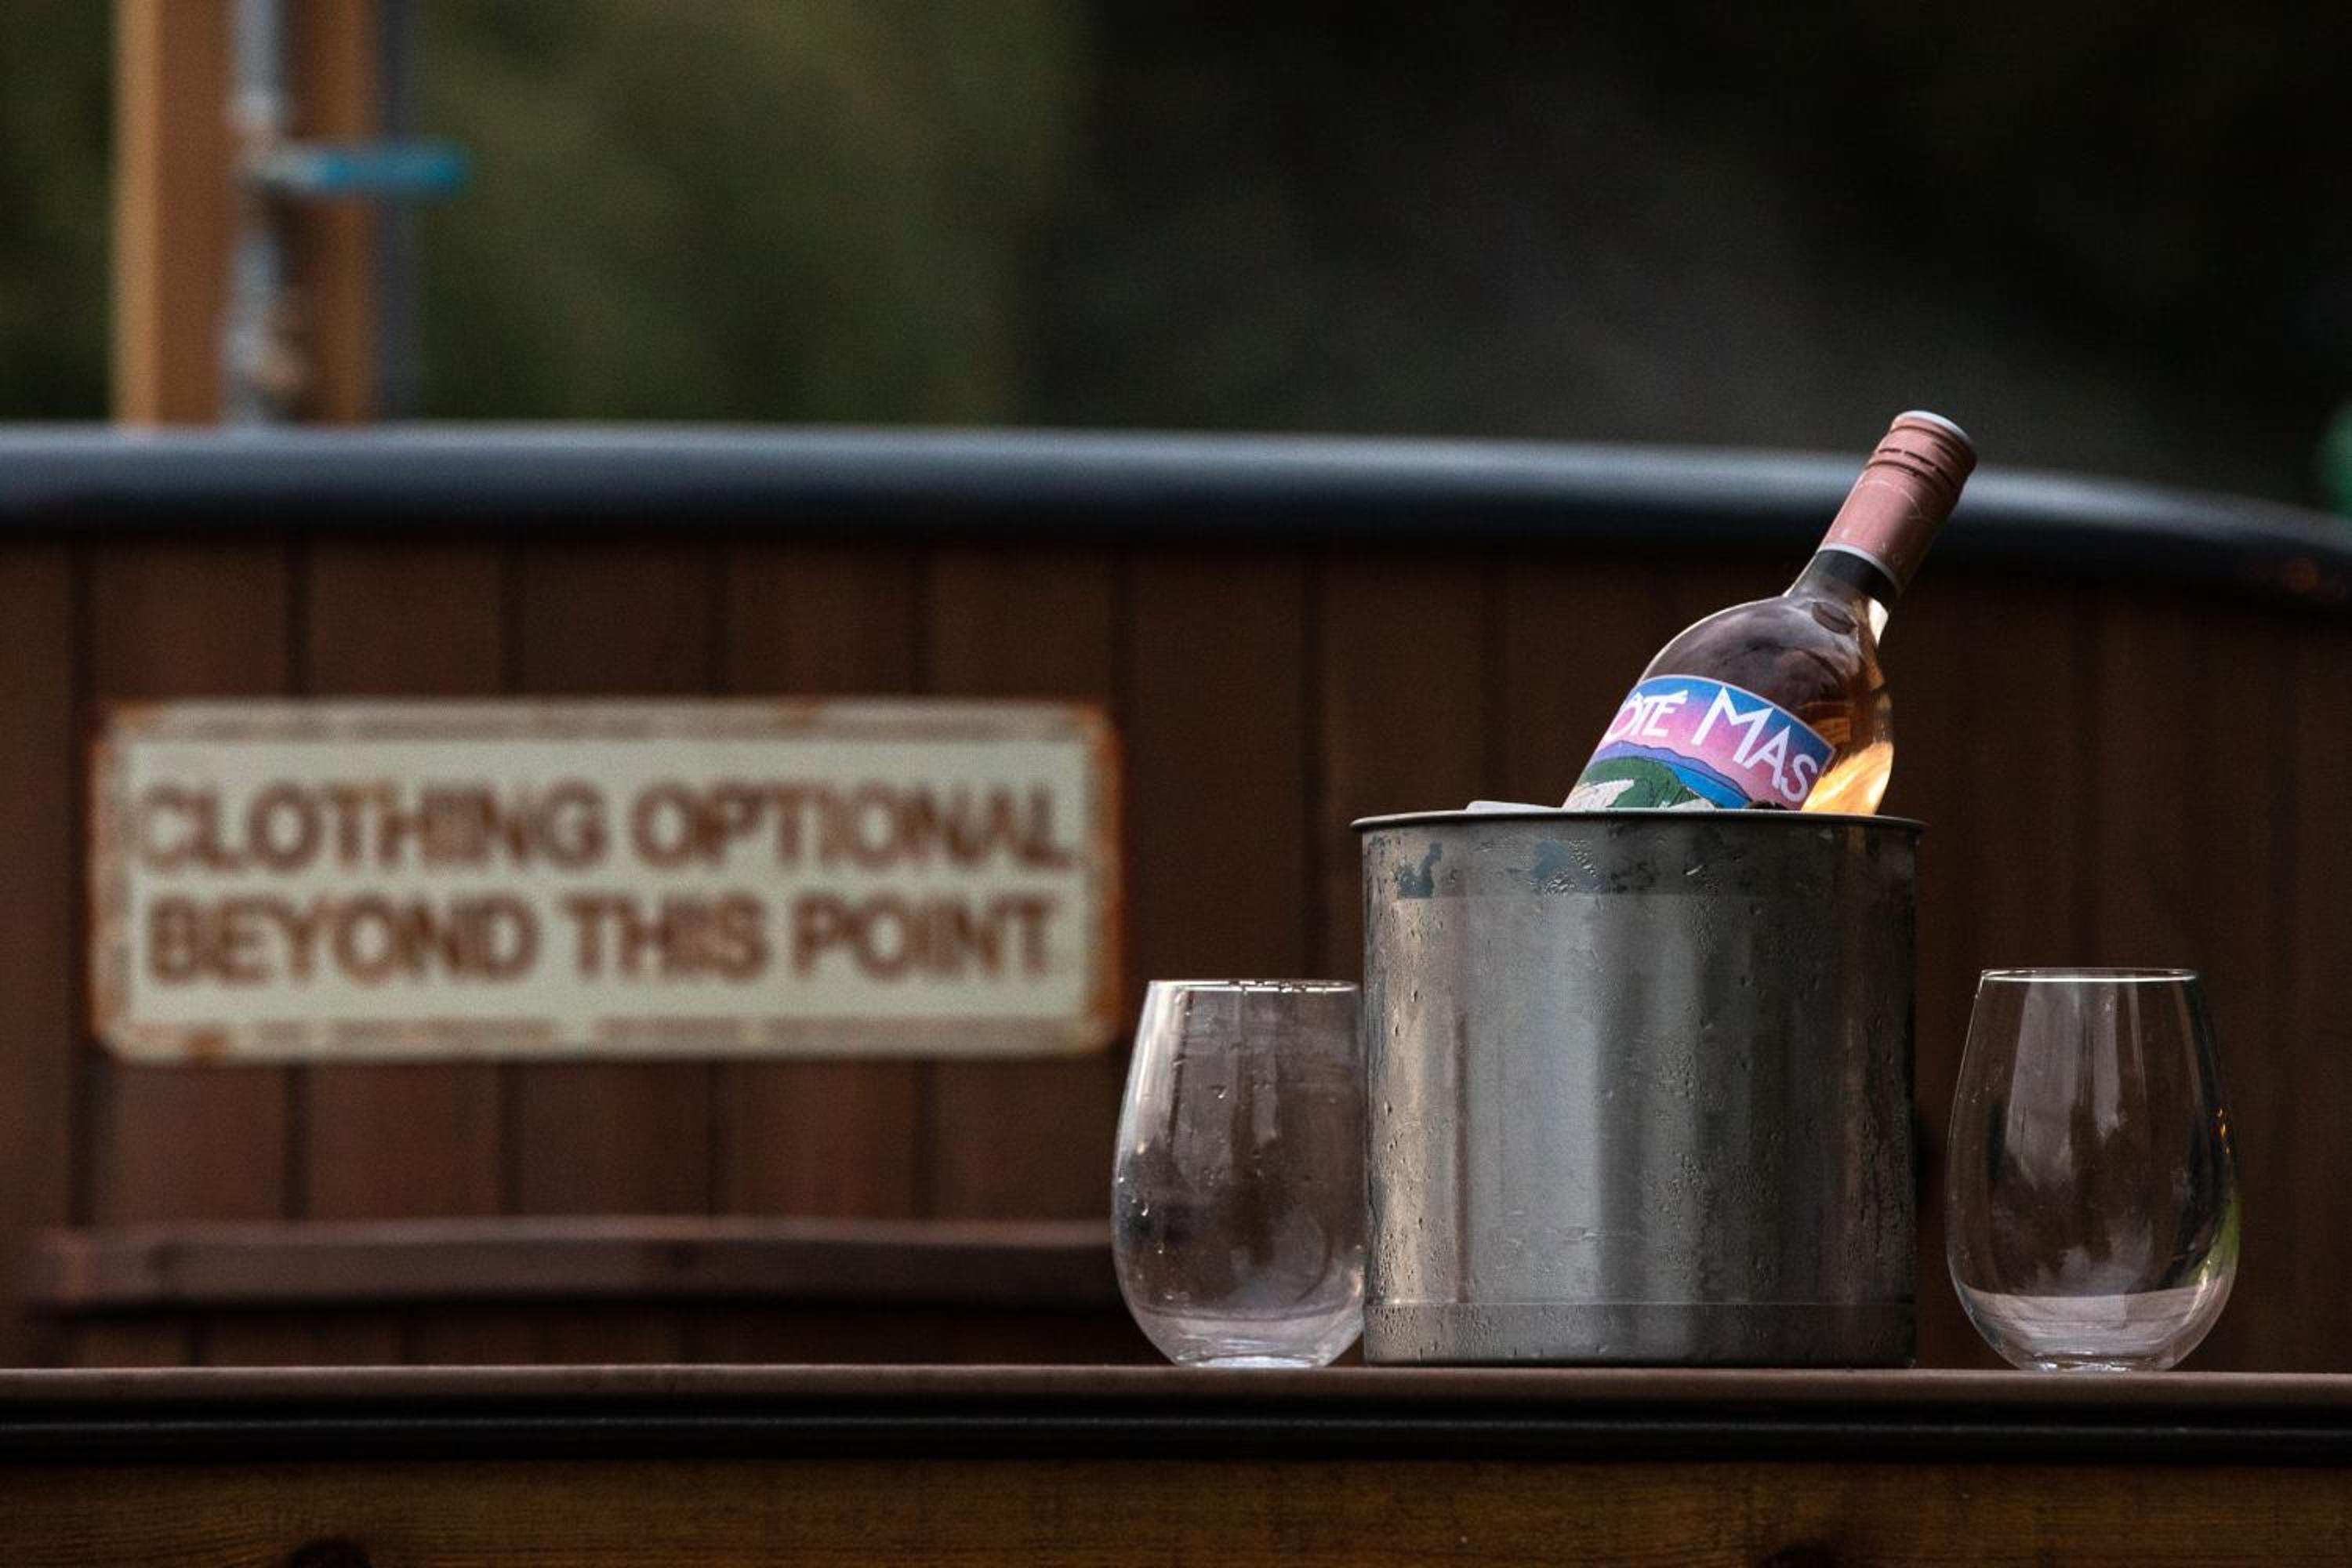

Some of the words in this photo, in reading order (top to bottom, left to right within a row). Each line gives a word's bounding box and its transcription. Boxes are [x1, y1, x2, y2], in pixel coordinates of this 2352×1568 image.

[1605, 689, 1689, 742] ÔTÉ
[1691, 685, 1819, 803] MAS
[143, 782, 610, 873] CLOTHING
[632, 781, 1075, 873] OPTIONAL
[147, 892, 543, 985] BEYOND
[557, 891, 769, 985] THIS
[789, 892, 1057, 985] POINT
